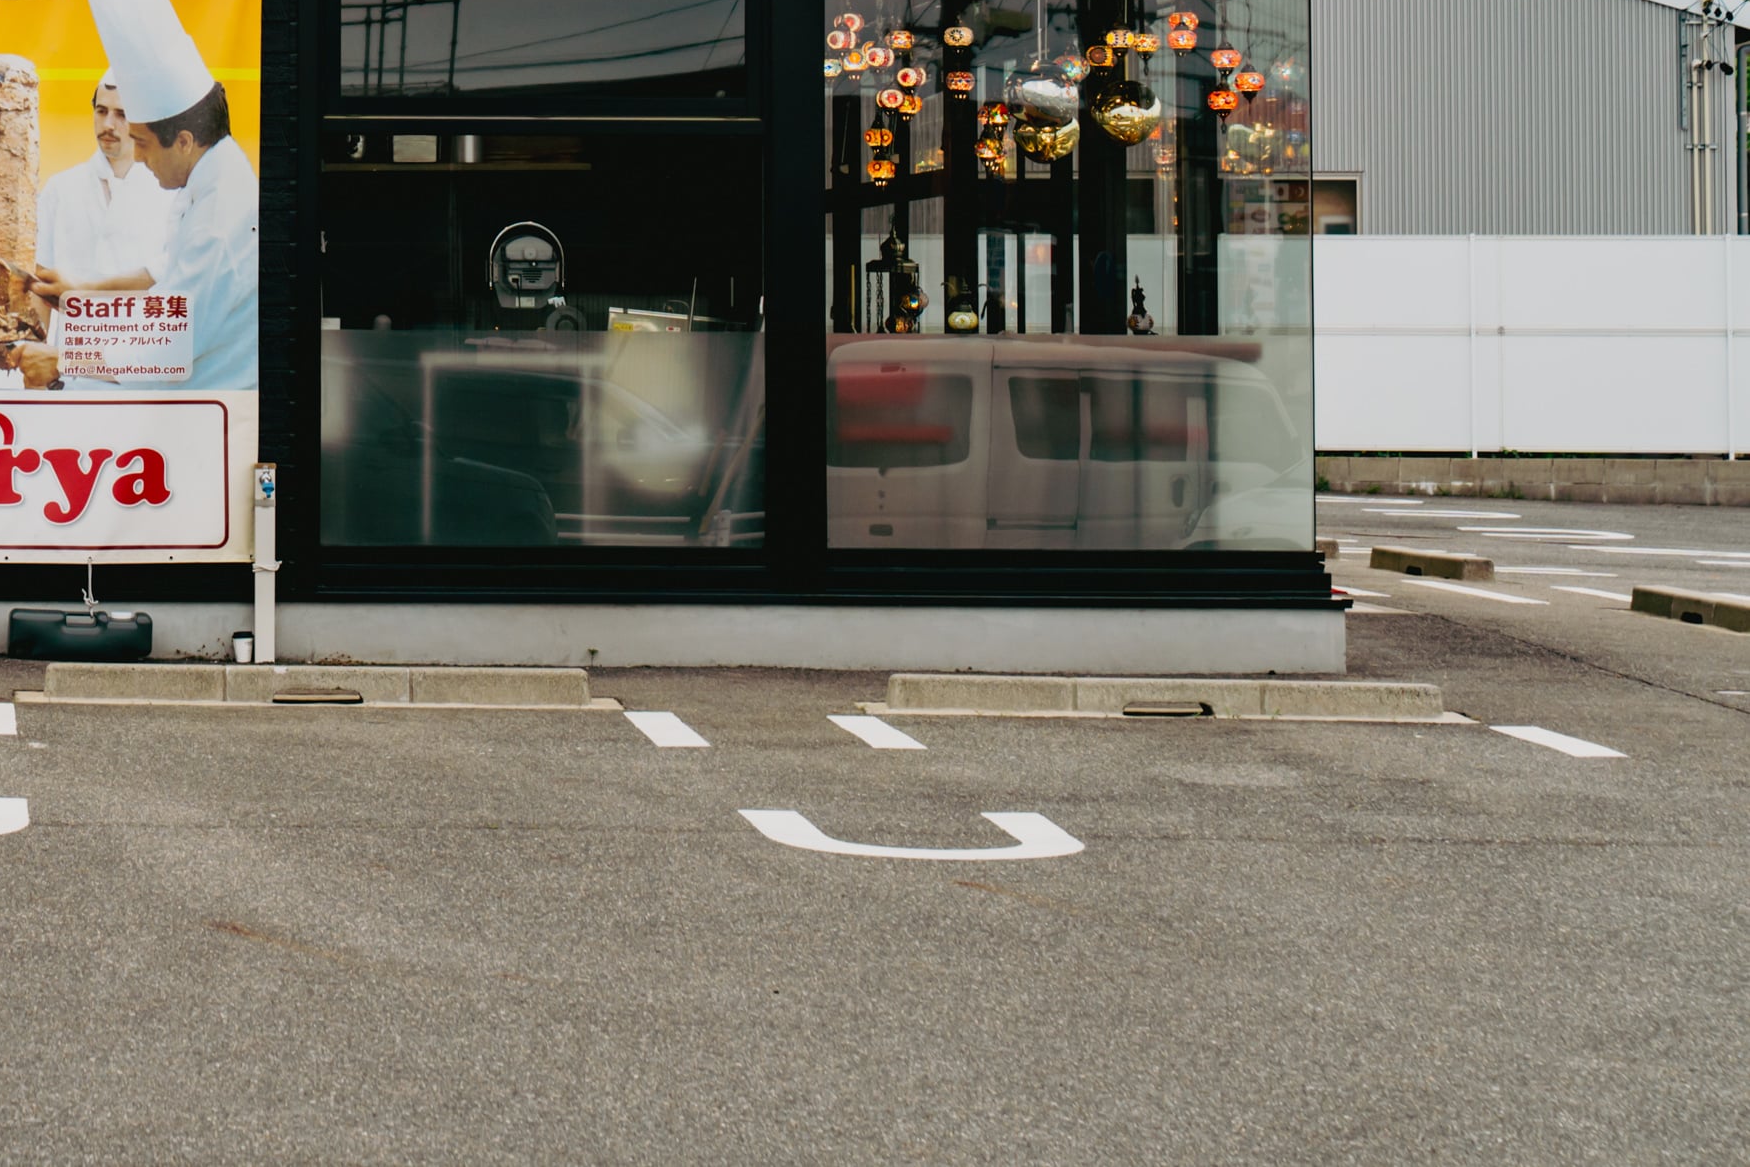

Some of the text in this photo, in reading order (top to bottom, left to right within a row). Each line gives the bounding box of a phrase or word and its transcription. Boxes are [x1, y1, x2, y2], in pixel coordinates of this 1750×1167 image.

[65, 296, 188, 319] Staff 募集
[64, 322, 188, 332] Recruitment of Staff
[64, 351, 103, 361] 問合せ先
[64, 365, 186, 376] info@MegaKebab.com
